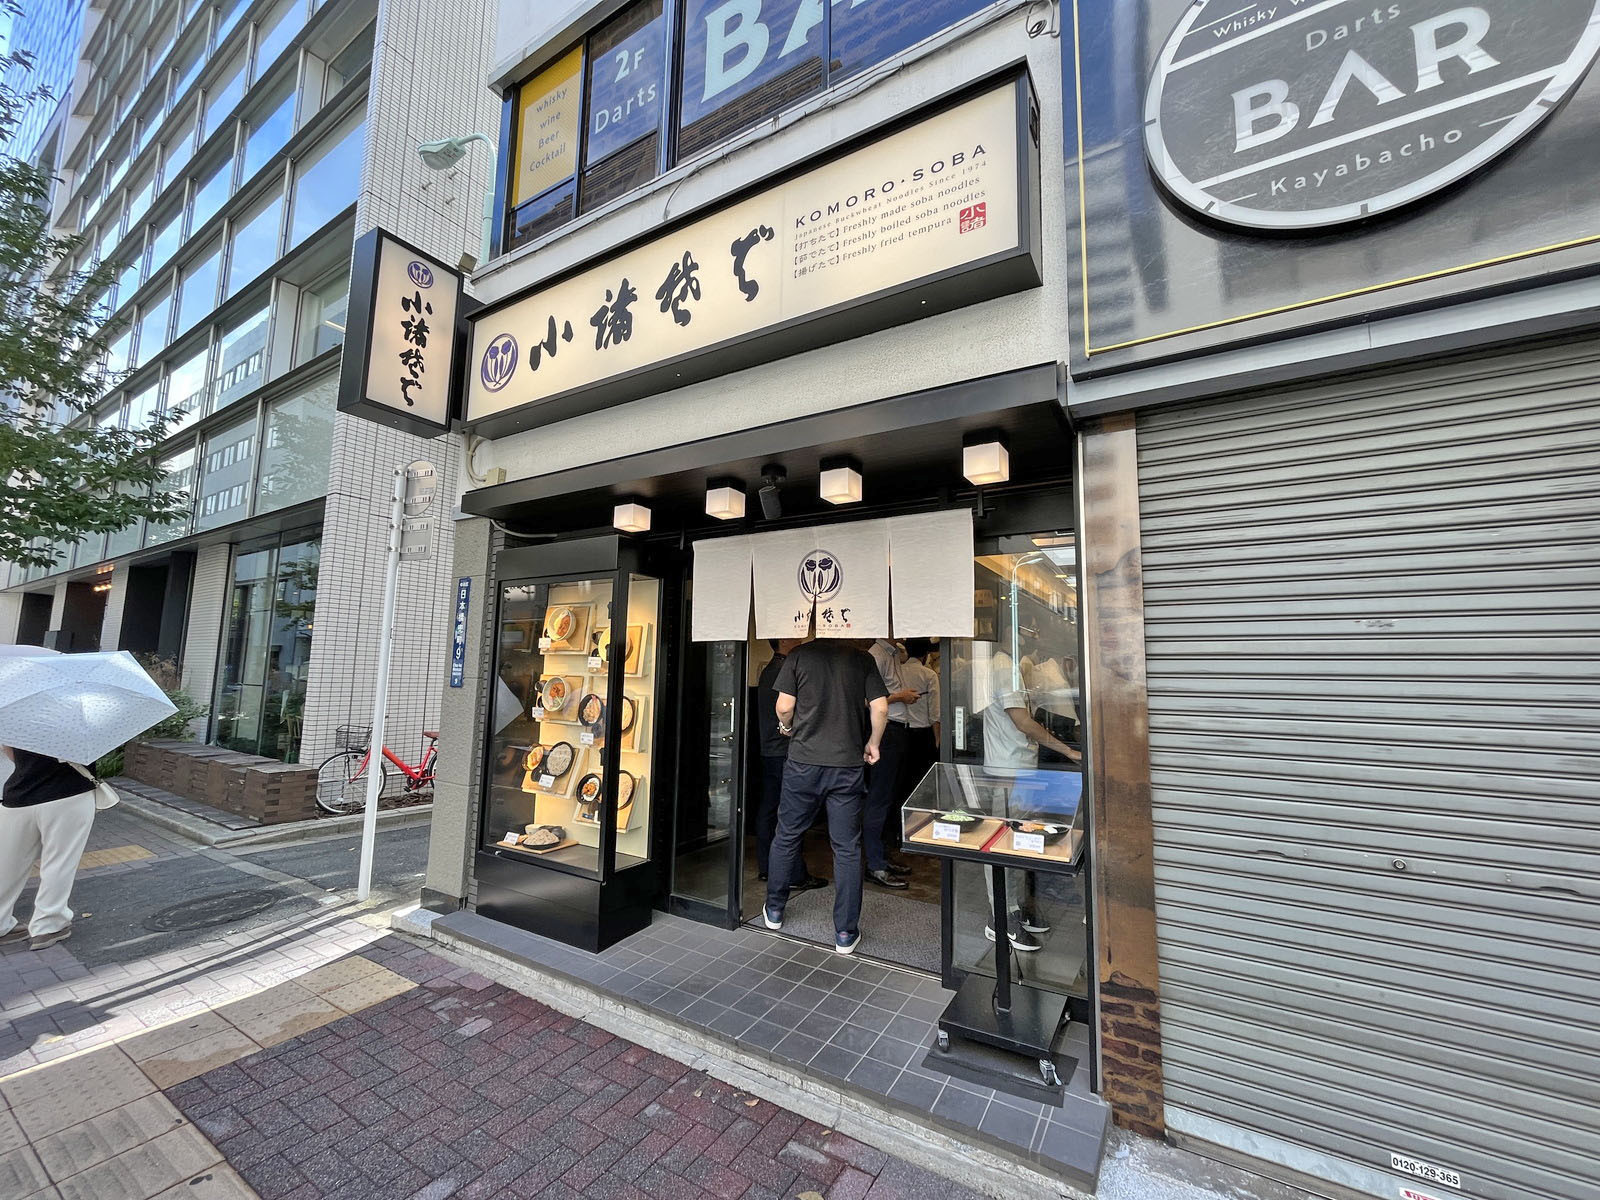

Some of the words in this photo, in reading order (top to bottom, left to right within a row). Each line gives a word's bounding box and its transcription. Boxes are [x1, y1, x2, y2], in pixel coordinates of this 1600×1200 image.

[1213, 7, 1277, 38] Whisky
[1306, 3, 1400, 51] Darts
[614, 47, 645, 83] 2F
[1233, 6, 1501, 153] BAR
[536, 88, 568, 113] whisky
[539, 111, 561, 129] wine
[594, 83, 656, 134] Darts
[529, 142, 566, 172] Cocktail
[538, 130, 560, 150] Beer
[1271, 127, 1463, 197] Kayabacho
[794, 222, 831, 240] Japanese
[835, 202, 882, 224] Buckwheat
[886, 186, 924, 204] Noodles
[929, 173, 956, 188] Since
[962, 161, 987, 175] 1974
[843, 215, 877, 233] Freshly
[880, 205, 907, 219] made
[910, 195, 933, 208] soba
[937, 177, 980, 198] noodles
[843, 229, 877, 247] Freshly
[880, 216, 911, 233] boiled
[915, 208, 938, 221] soba
[943, 190, 986, 211] noodles
[843, 243, 877, 261] Freshly
[880, 233, 904, 248] fried
[908, 217, 952, 238] tempura
[1392, 1157, 1459, 1185] 0120-129-365
